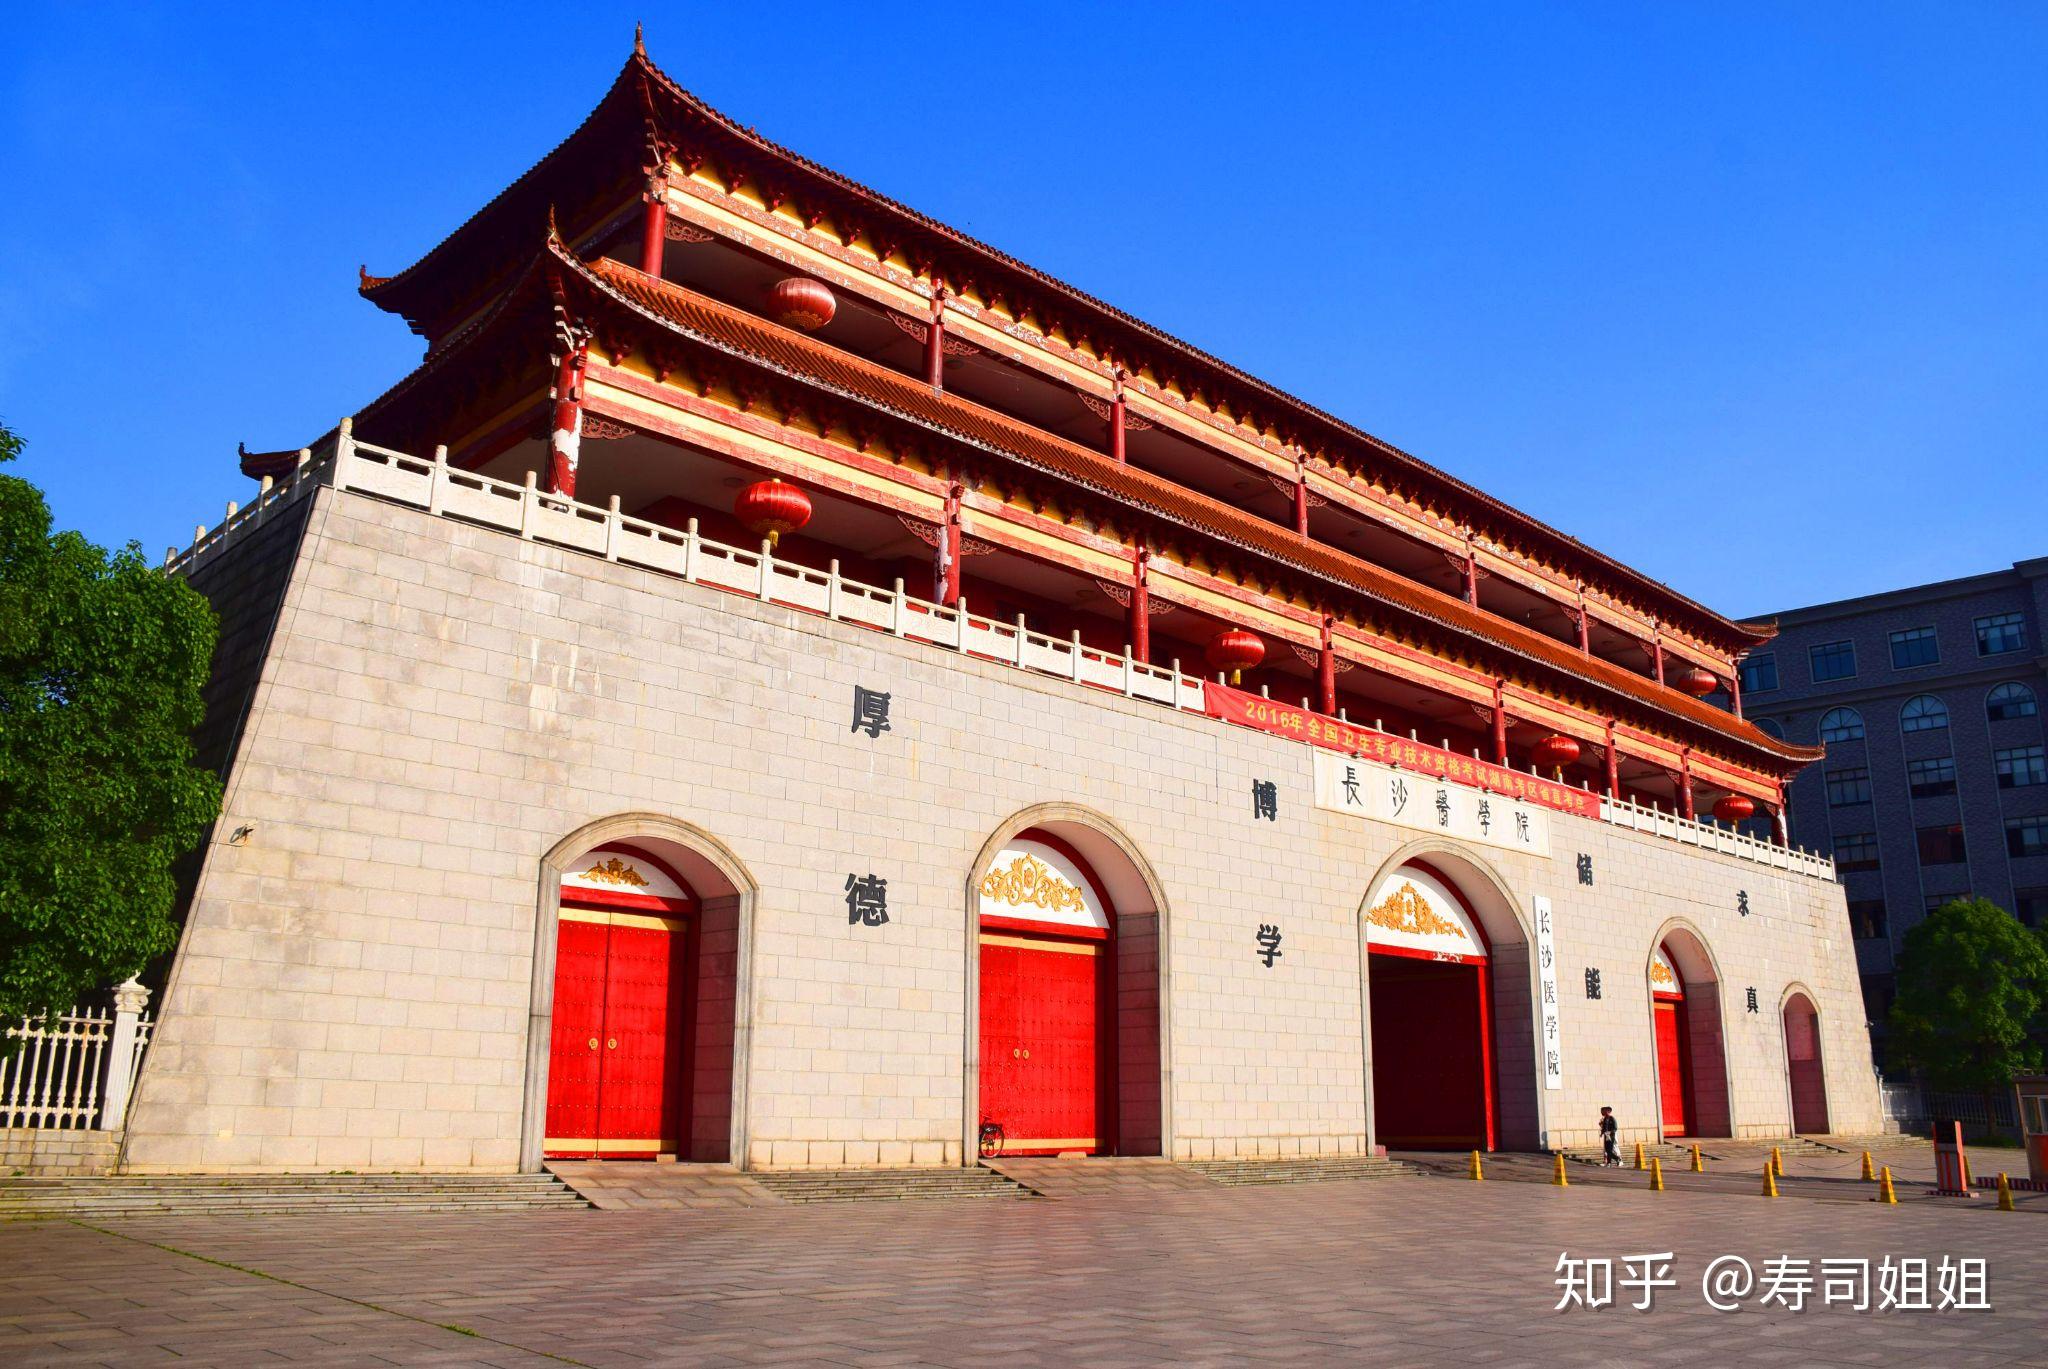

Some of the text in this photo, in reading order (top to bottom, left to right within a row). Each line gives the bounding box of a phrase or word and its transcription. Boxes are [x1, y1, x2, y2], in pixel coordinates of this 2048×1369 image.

[1539, 909, 1560, 1075] 长沙医学院
